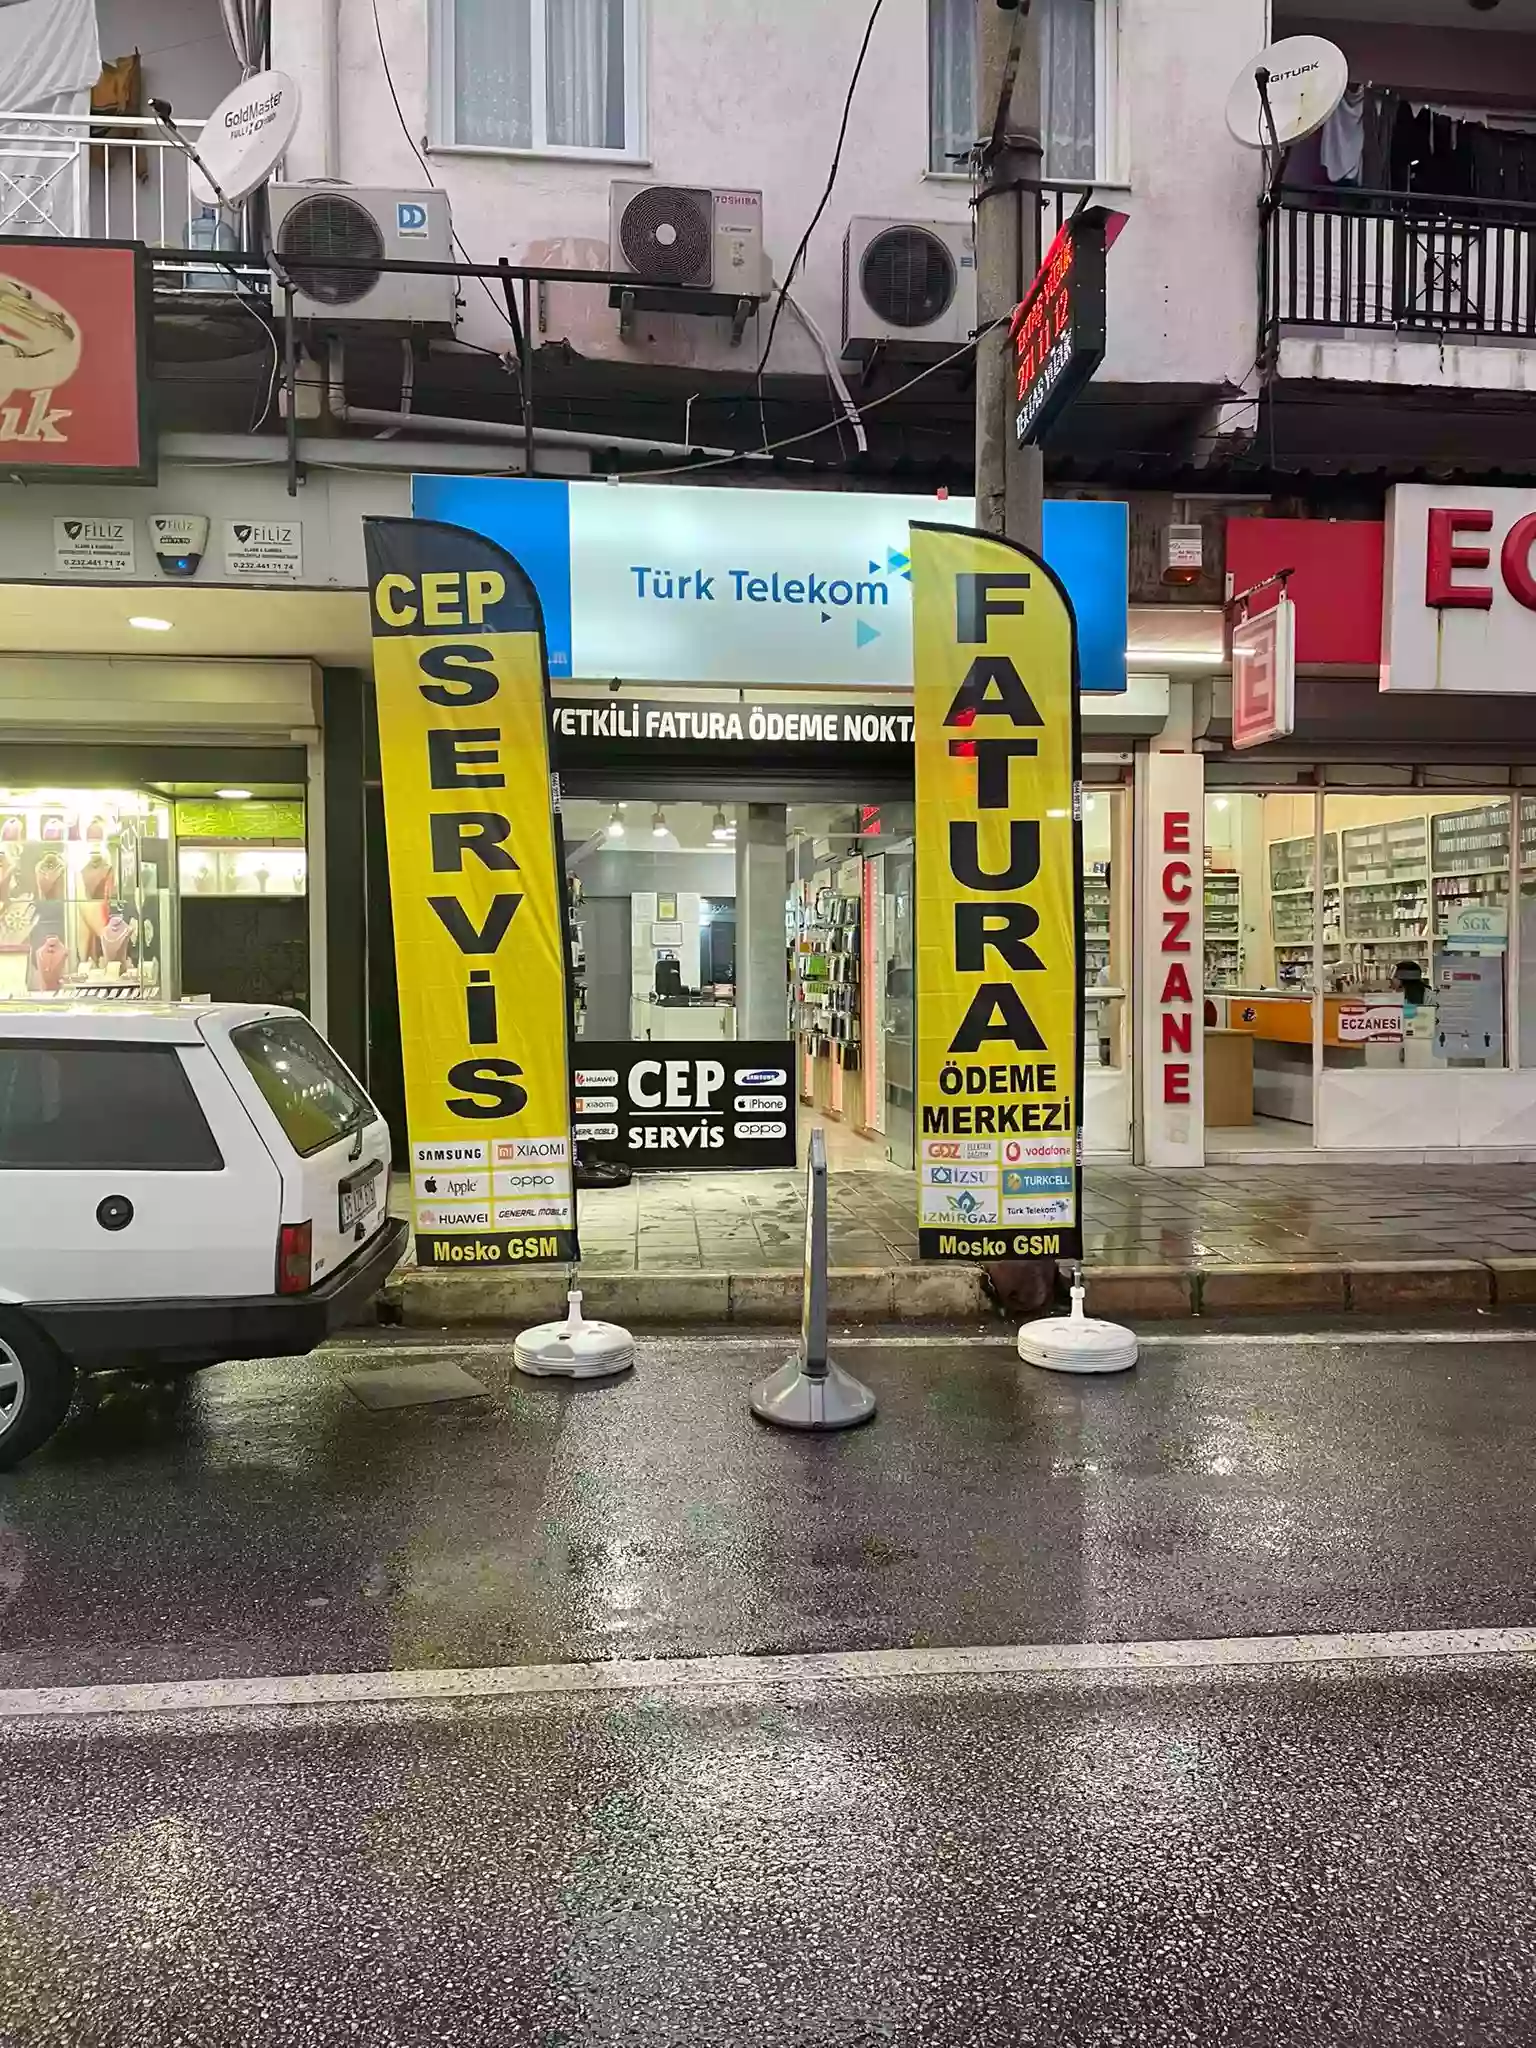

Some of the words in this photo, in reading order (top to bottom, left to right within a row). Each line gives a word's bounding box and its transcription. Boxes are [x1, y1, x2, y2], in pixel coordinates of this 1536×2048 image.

[224, 90, 282, 128] GoldMaster
[714, 195, 758, 206] TOSHIBA
[85, 521, 124, 538] FİLİZ
[254, 525, 292, 542] FİLİZ
[630, 566, 715, 601] Türk
[728, 569, 888, 606] Telekom
[375, 570, 506, 627] CEP
[645, 711, 744, 740] FATURA
[749, 706, 839, 742] ÖDEME
[942, 573, 1049, 1053] FATURA
[418, 644, 529, 1119] SERVİS
[1462, 917, 1492, 931] SGK
[1160, 811, 1193, 1104] ECZANE
[1341, 1016, 1401, 1030] ECZANESİ
[627, 1060, 725, 1108] CEP
[939, 1060, 1057, 1095] ÖDEME
[749, 1098, 783, 1109] iPhone
[922, 1095, 1071, 1134] MERKEZİ
[627, 1118, 725, 1149] SERVİS
[739, 1124, 782, 1135] oppo
[418, 1148, 482, 1161] SAMSUNG
[517, 1143, 565, 1157] XIAOMI
[1025, 1145, 1071, 1157] vodafone
[510, 1175, 555, 1188] oppo
[953, 1166, 989, 1184] İZSU
[1024, 1174, 1071, 1186] TURKCELL
[447, 1179, 479, 1196] Apple
[498, 1209, 537, 1219] GENERAL
[538, 1207, 569, 1217] MOBILE
[1007, 1206, 1024, 1215] Türk
[1026, 1205, 1057, 1215] Telekom
[438, 1213, 489, 1225] HUAWEI
[433, 1240, 501, 1262] Mosko
[507, 1236, 558, 1260] GSM
[939, 1234, 1006, 1256] Mosko
[1013, 1234, 1060, 1256] GSM
